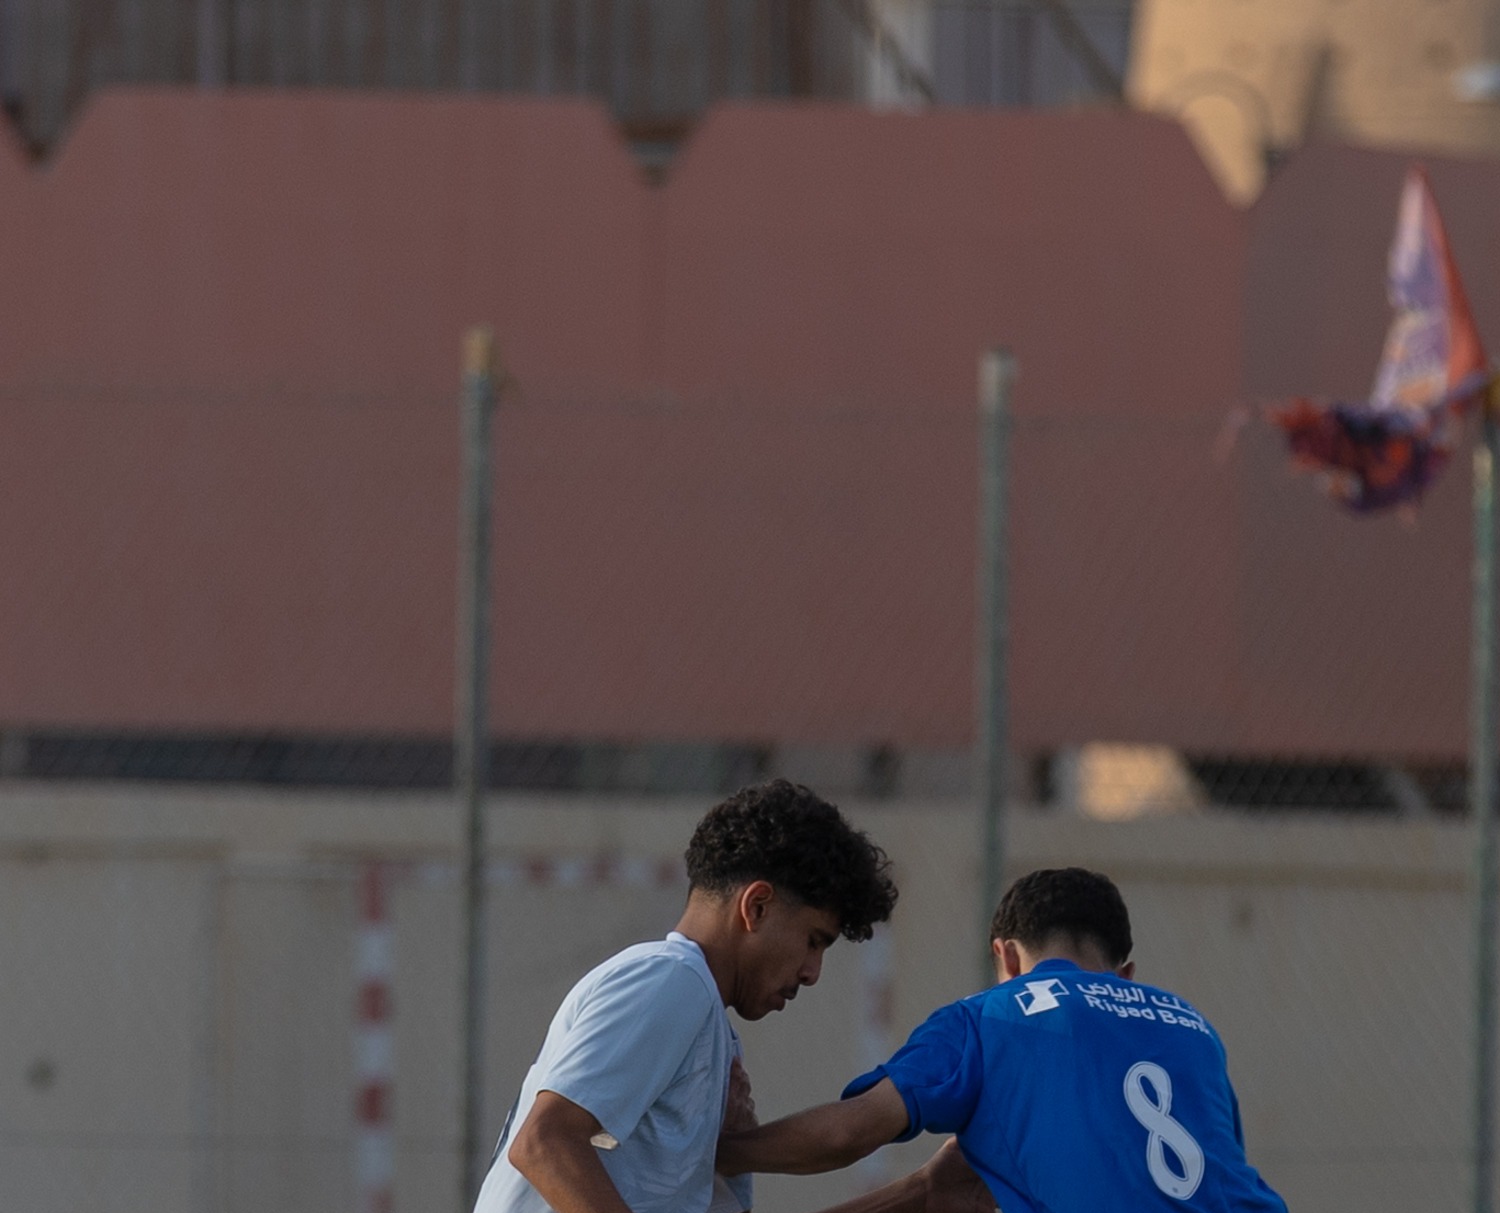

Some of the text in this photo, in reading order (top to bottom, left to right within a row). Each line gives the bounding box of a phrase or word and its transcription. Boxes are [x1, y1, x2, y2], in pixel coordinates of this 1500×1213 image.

[1076, 982, 1146, 1004] الرياض
[1084, 994, 1156, 1020] Riyad
[1123, 1060, 1206, 1200] 8
